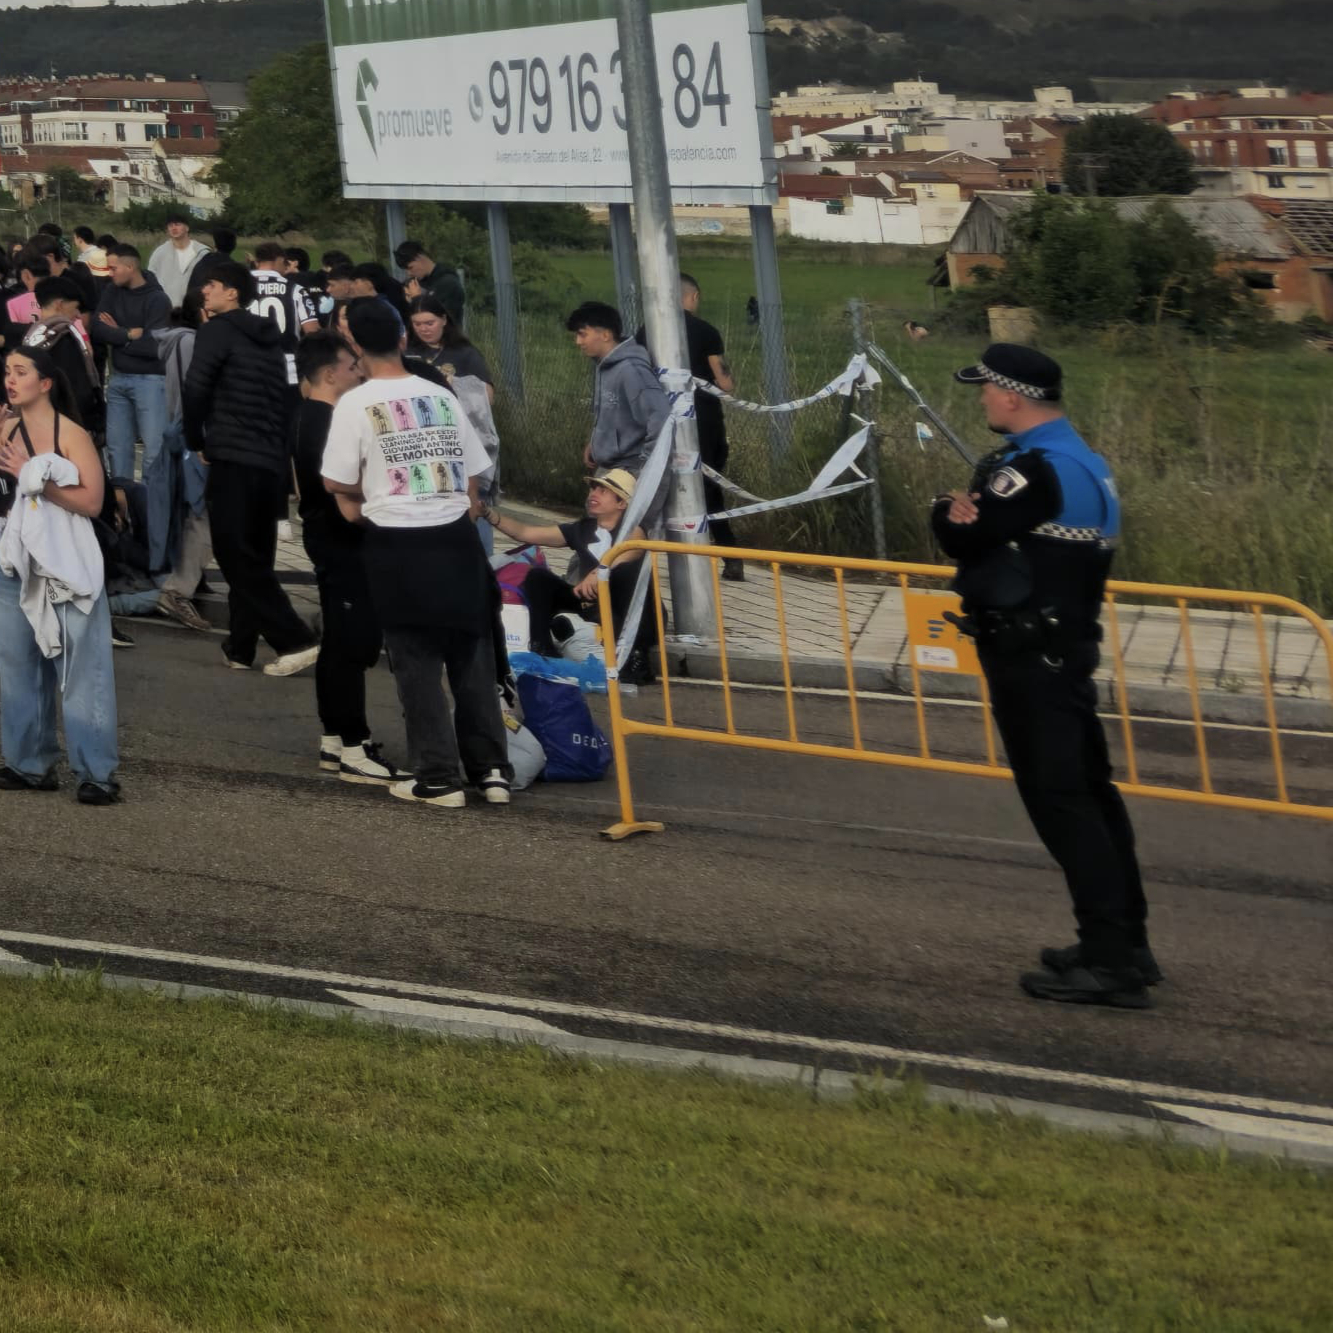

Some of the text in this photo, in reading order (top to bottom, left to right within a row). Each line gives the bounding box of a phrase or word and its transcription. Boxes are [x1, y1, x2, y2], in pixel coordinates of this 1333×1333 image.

[488, 57, 552, 135] 979
[559, 52, 602, 133] 16
[672, 41, 731, 129] 84
[377, 108, 453, 146] promueve
[257, 282, 286, 295] PIERO
